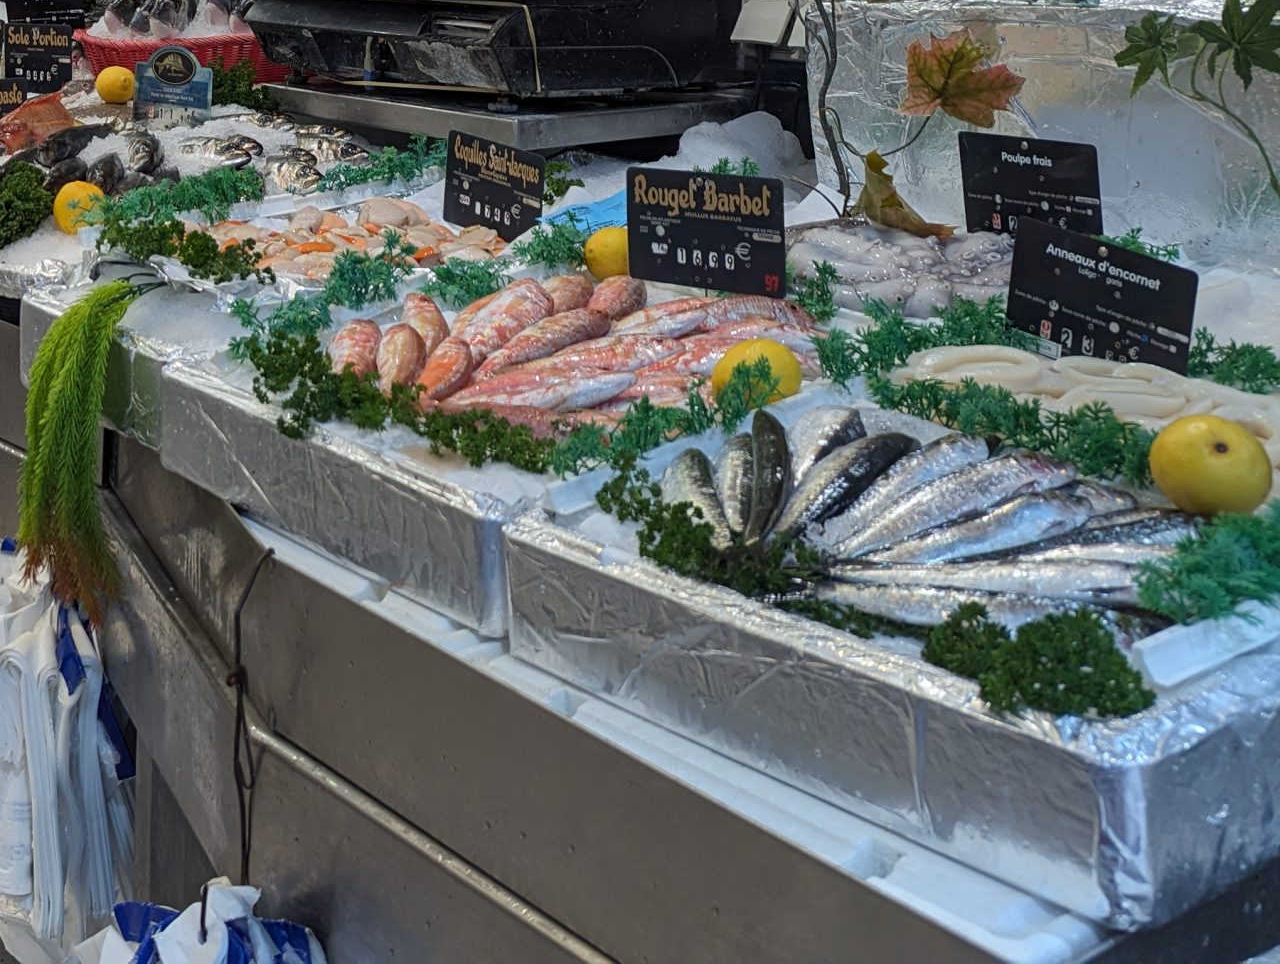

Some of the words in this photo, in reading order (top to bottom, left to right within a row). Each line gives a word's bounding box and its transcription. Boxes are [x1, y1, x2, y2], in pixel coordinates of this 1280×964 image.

[8, 26, 30, 45] Sole
[32, 26, 68, 47] Portion
[455, 135, 487, 170] Coquilles
[489, 144, 539, 188] Saint-Jacques
[1002, 152, 1031, 165] Poulpe
[1033, 155, 1052, 167] frais
[634, 174, 696, 216] Rouget
[703, 179, 770, 216] Barbet
[511, 204, 521, 219] €
[685, 211, 709, 219] MULLUS
[1059, 217, 1067, 230] €
[735, 242, 751, 261] €
[1046, 243, 1095, 268] Anneaux
[1098, 257, 1161, 291] d'encornet
[1078, 267, 1096, 279] Loligo
[1129, 346, 1140, 360] €
